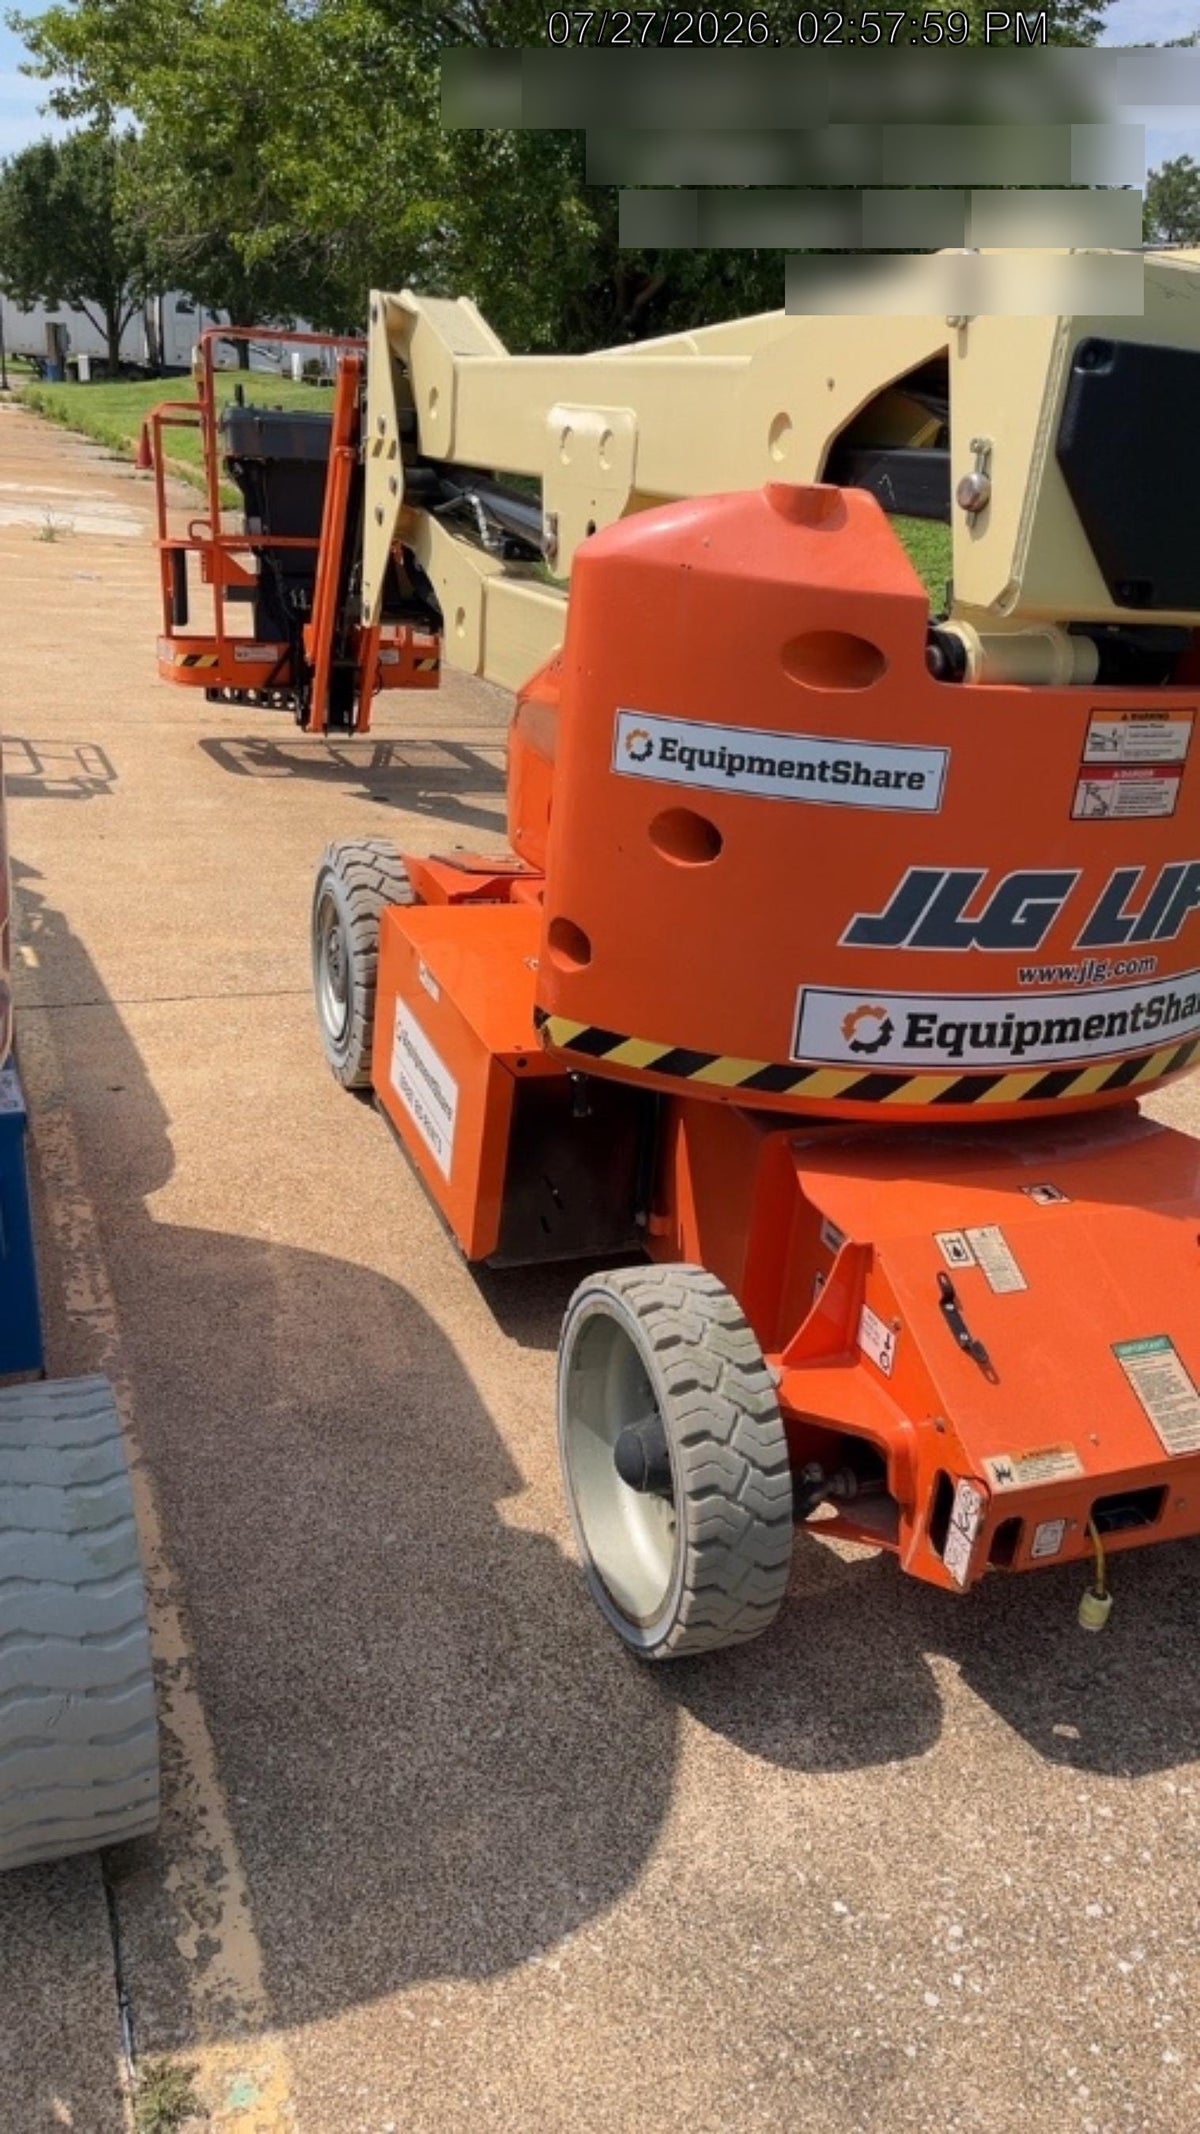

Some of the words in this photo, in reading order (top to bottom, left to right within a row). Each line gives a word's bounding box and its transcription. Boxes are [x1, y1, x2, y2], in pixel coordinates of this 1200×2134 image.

[658, 736, 926, 791] EquipmentShare
[837, 865, 1084, 951] JLG
[1017, 956, 1157, 986] www.jlg.com
